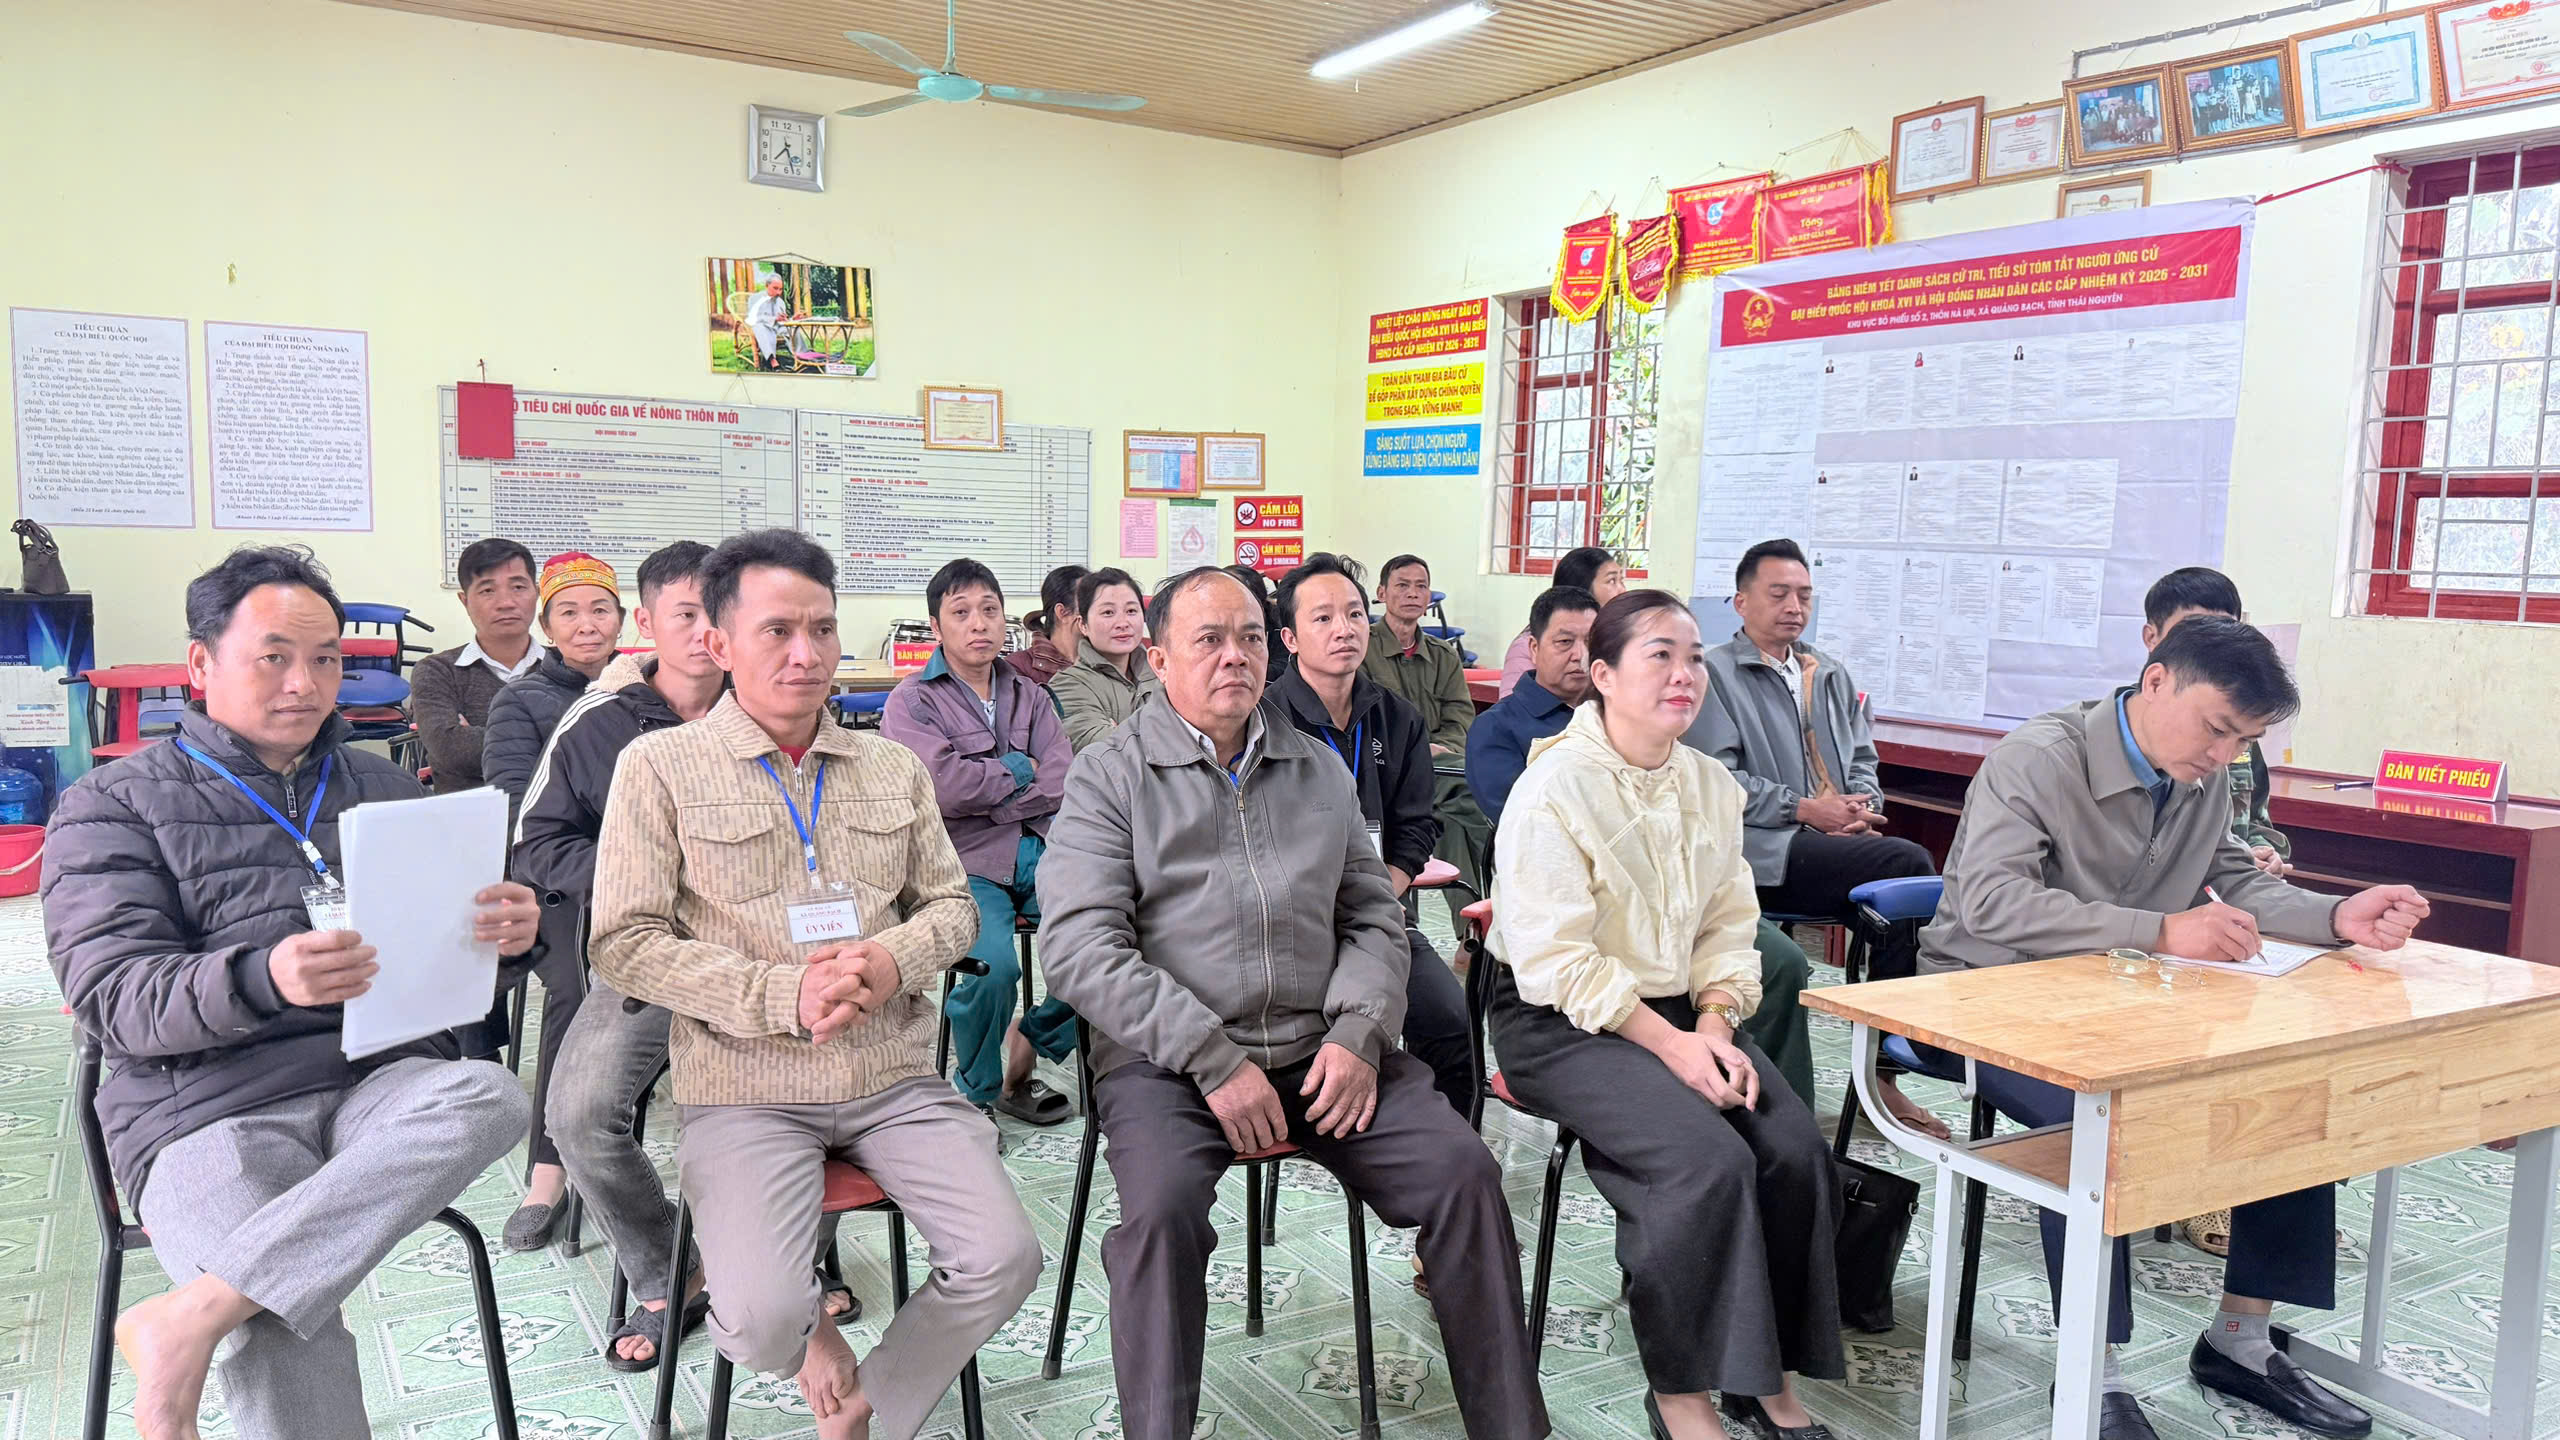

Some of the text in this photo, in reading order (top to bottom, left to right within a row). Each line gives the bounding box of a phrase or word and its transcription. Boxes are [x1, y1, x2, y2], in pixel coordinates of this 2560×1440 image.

[1897, 278, 1922, 290] DANH
[1897, 296, 1912, 308] XVI
[2139, 268, 2168, 282] 2026
[2179, 264, 2208, 279] 2031
[523, 399, 549, 413] TIÊU
[552, 401, 572, 414] CHÍ
[576, 400, 607, 416] QUỐC
[610, 405, 629, 417] GIA
[633, 402, 647, 418] VỀ
[650, 405, 682, 420] NÔNG
[685, 407, 714, 422] THÔN
[718, 409, 739, 424] MỚI
[1260, 501, 1300, 515] CẤM LỬA
[1263, 519, 1276, 527] NO
[2385, 761, 2490, 788] BÀN VIẾT PHIẾU
